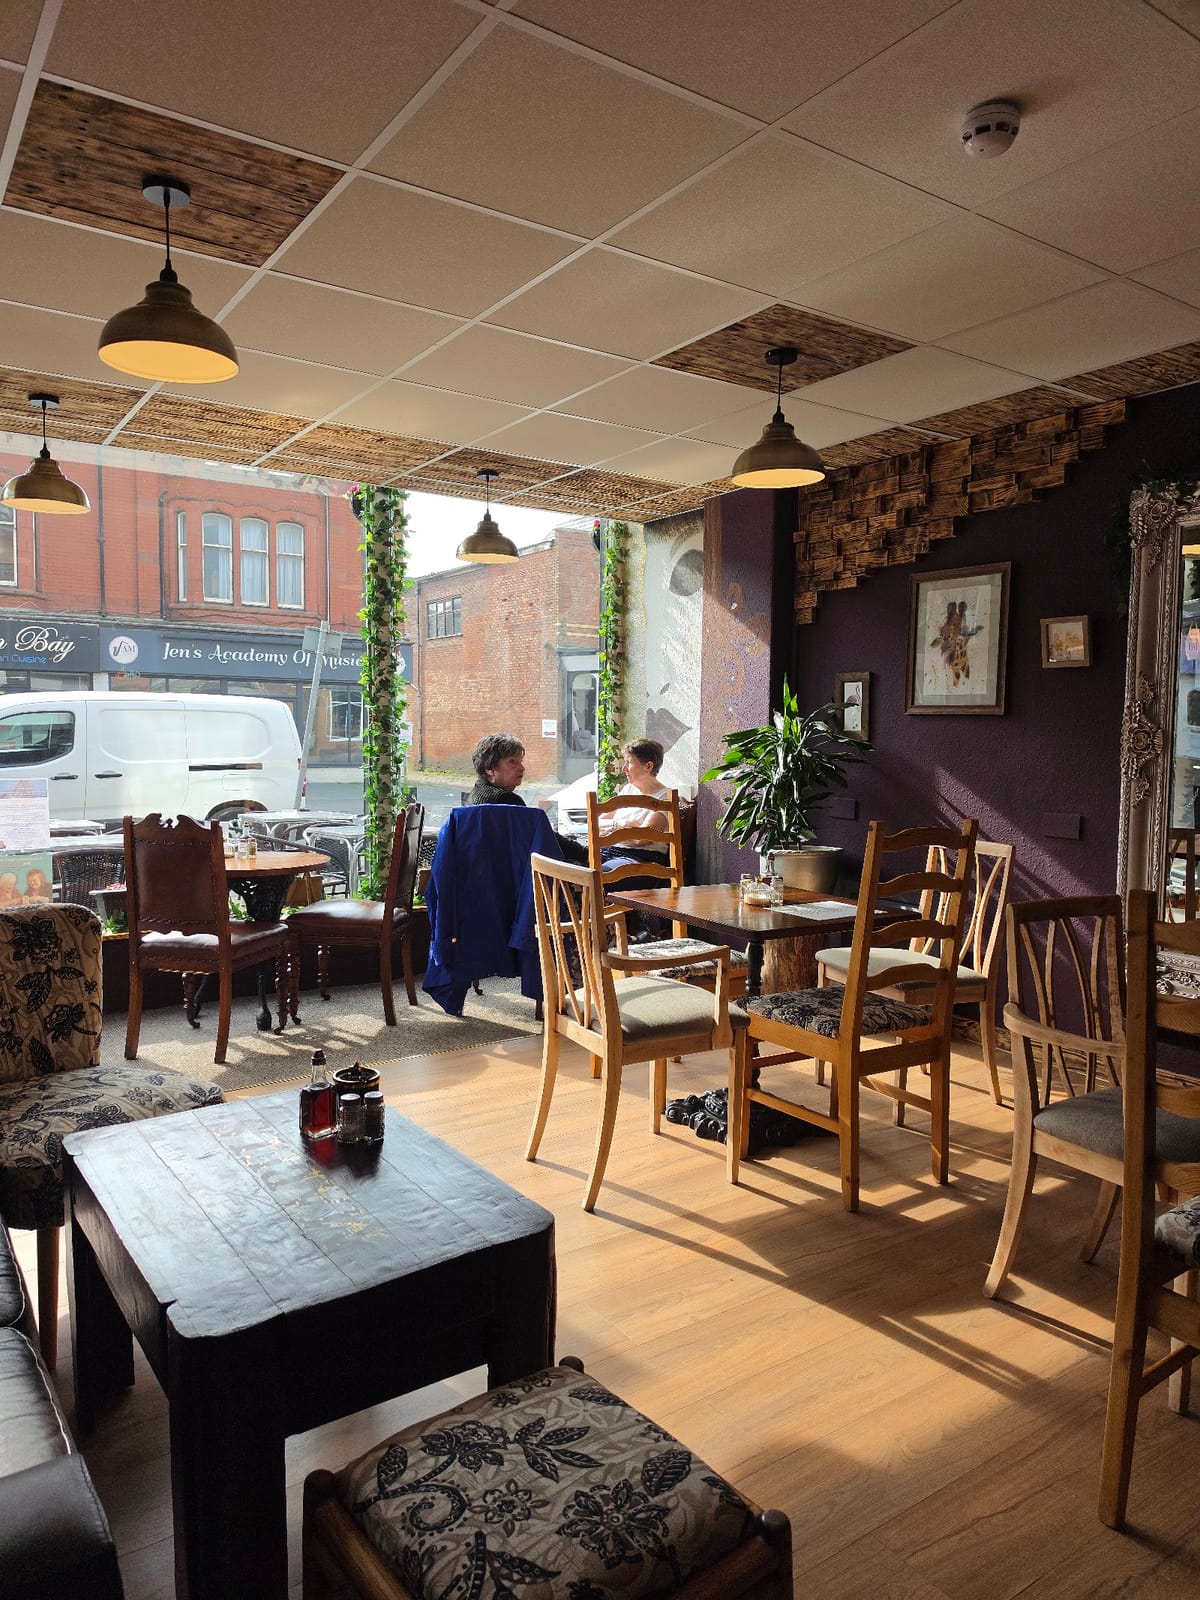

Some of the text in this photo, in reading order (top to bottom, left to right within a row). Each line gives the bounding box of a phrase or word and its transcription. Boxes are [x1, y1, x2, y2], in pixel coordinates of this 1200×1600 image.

[15, 626, 75, 662] Bay
[163, 642, 202, 660] Jen's
[208, 644, 287, 665] Academy
[12, 654, 47, 663] Cuisine
